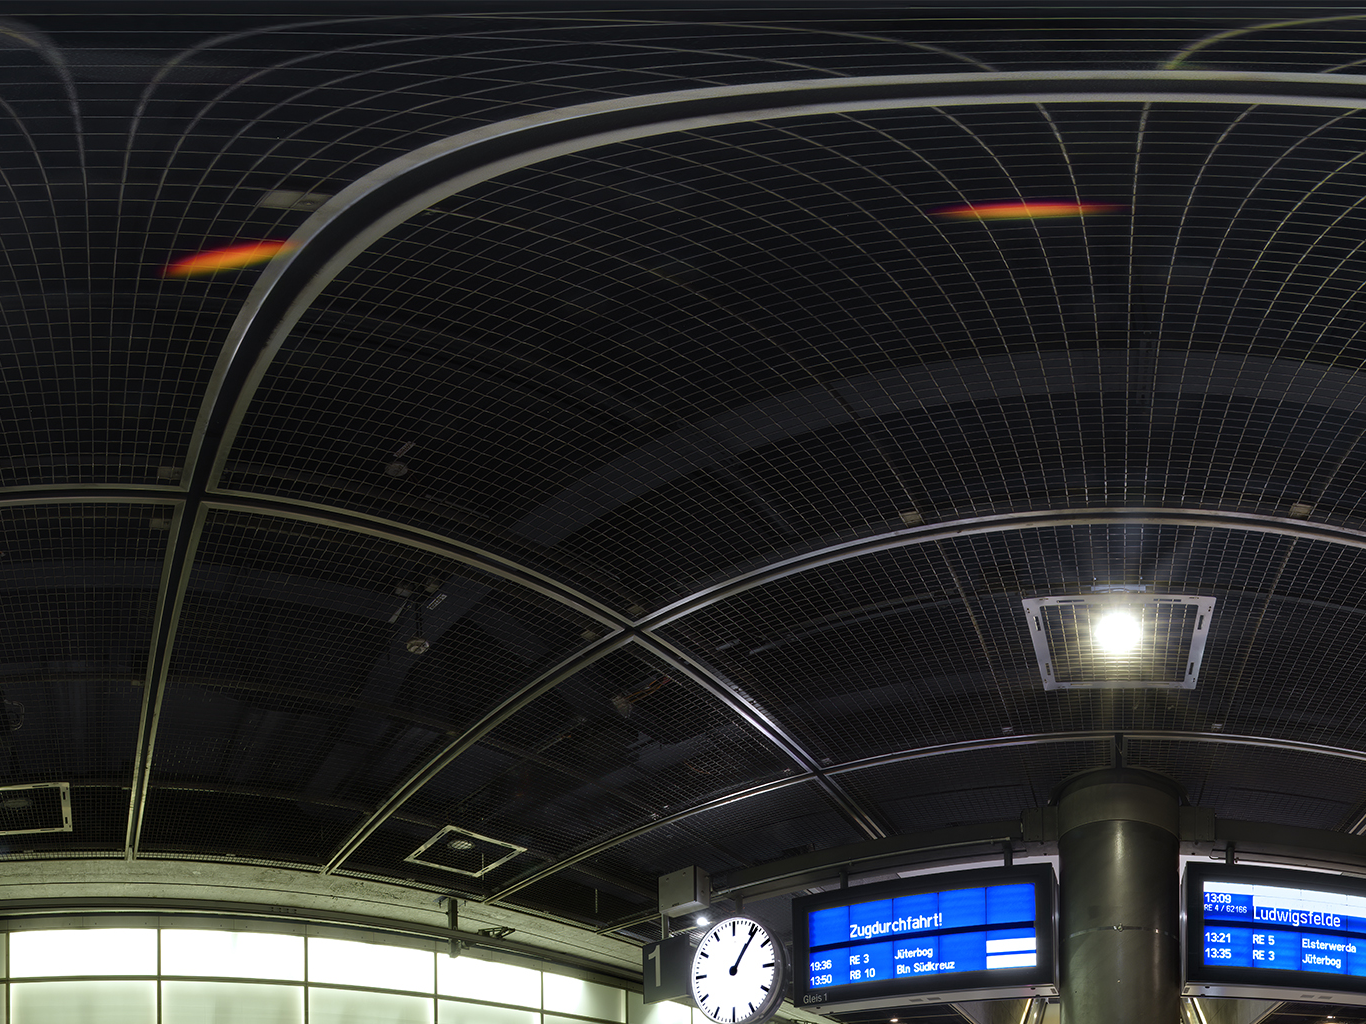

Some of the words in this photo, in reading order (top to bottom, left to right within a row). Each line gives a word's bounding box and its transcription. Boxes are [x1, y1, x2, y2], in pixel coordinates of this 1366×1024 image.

[1204, 893, 1232, 904] 13:09
[1204, 904, 1213, 912] RE
[1226, 905, 1248, 914] 62166
[849, 912, 943, 939] Zugdurchfahrt!
[1253, 906, 1341, 927] Ludwigsfelde
[1204, 932, 1232, 943] 13:21
[1252, 934, 1265, 945] RE
[1268, 935, 1275, 945] 5
[1301, 938, 1357, 953] Elsterwerda
[648, 944, 661, 987] 1
[849, 955, 861, 965] RE
[863, 953, 870, 963] 3
[894, 947, 934, 960] Jüterbog
[1204, 948, 1232, 959] 13:35
[1252, 950, 1265, 960] RE
[1268, 951, 1275, 961] 3
[1301, 954, 1342, 969] Jüterbog
[809, 973, 833, 986] 13:50
[849, 970, 861, 980] RB
[864, 967, 876, 978] 10
[896, 964, 911, 975] Bln
[913, 960, 955, 973] Südkreuz
[803, 994, 823, 1004] Gleis
[823, 993, 828, 1002] 1
